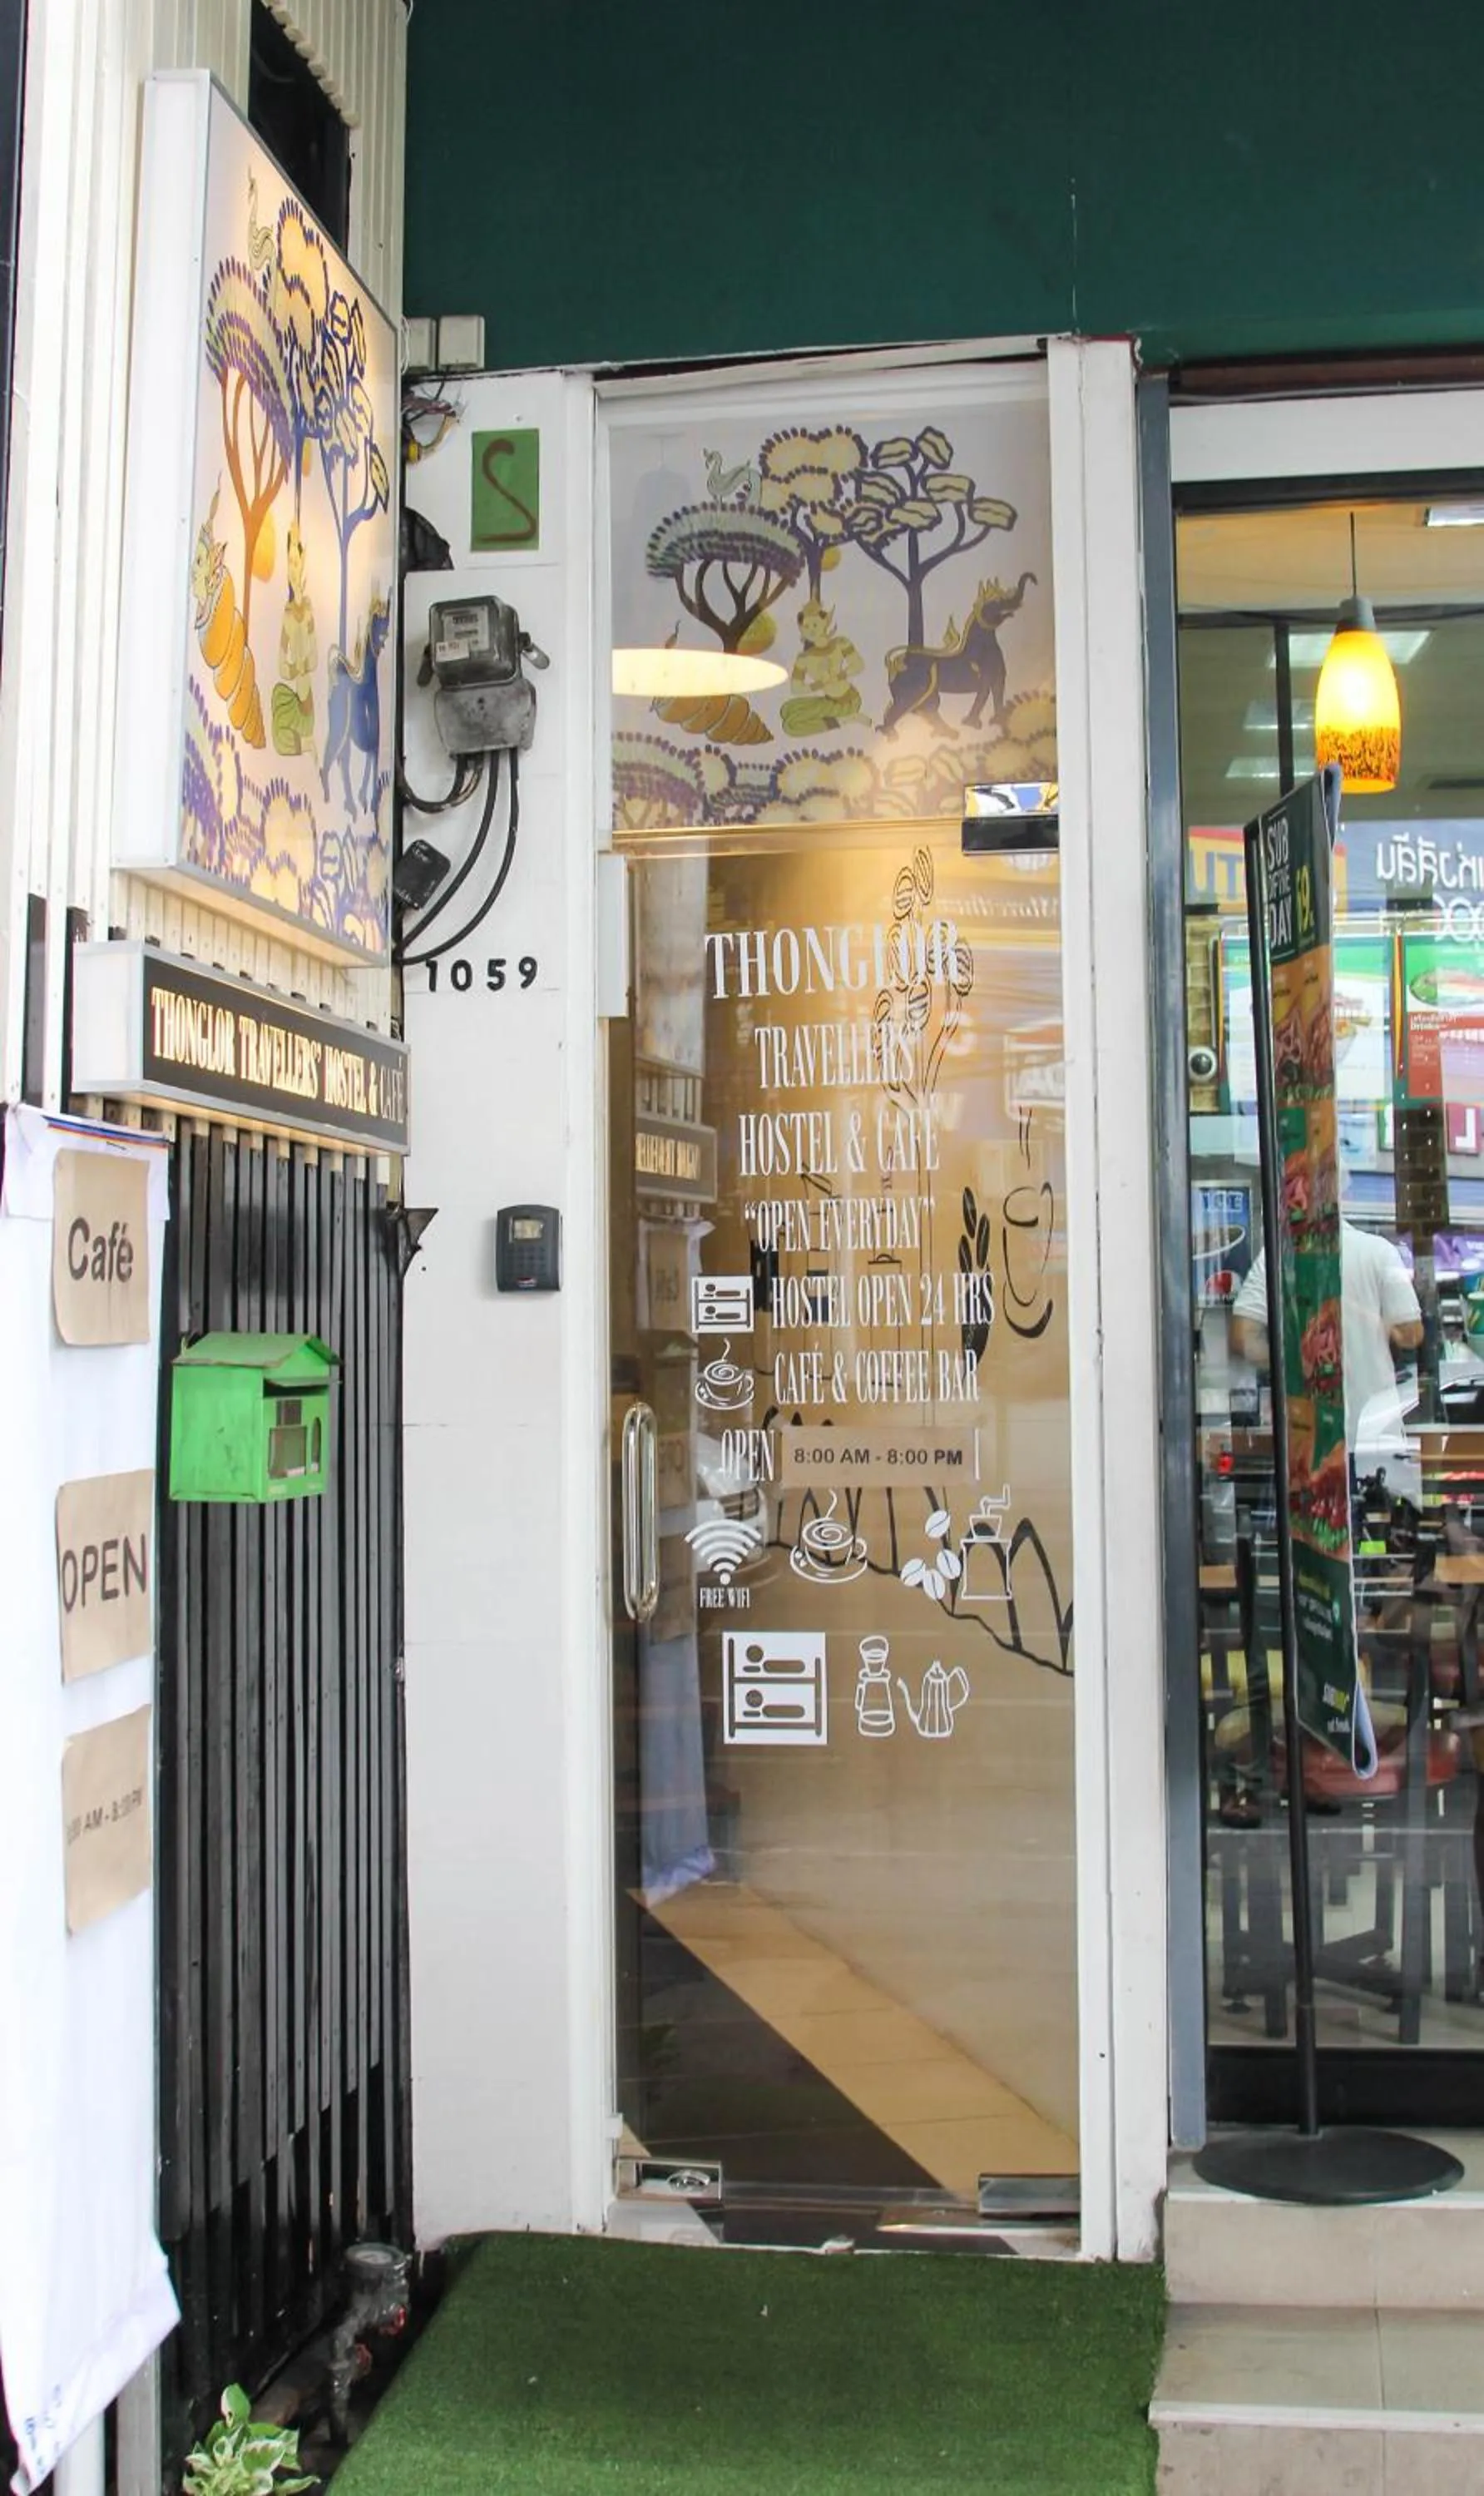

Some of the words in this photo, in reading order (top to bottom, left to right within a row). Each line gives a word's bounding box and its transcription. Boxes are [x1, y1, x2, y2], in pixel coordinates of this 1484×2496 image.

[1267, 817, 1289, 871] SUB
[1269, 894, 1292, 949] DAY
[425, 956, 538, 993] 1059
[705, 918, 959, 999] THONGLOR
[151, 986, 235, 1076] THONGLOR
[324, 1045, 367, 1113] HOSTEL
[369, 1061, 378, 1117] &
[739, 1111, 838, 1176] HOSTEL
[848, 1110, 868, 1173] &
[67, 1216, 134, 1283] Café
[771, 1275, 850, 1329] HOSTEL
[858, 1274, 913, 1327] OPEN
[919, 1273, 946, 1325] 24
[953, 1271, 996, 1325] HRS
[774, 1341, 824, 1404] CAFÉ
[831, 1350, 848, 1404] &
[854, 1350, 931, 1404] COFFEE
[938, 1349, 981, 1403] BAR
[720, 1429, 775, 1482] OPEN
[794, 1449, 834, 1464] 8:00
[839, 1449, 870, 1464] AM
[887, 1449, 928, 1464] 8:00
[934, 1449, 963, 1465] PM
[62, 1533, 147, 1613] OPEN
[700, 1587, 725, 1608] FREE
[727, 1587, 750, 1608] WIFI
